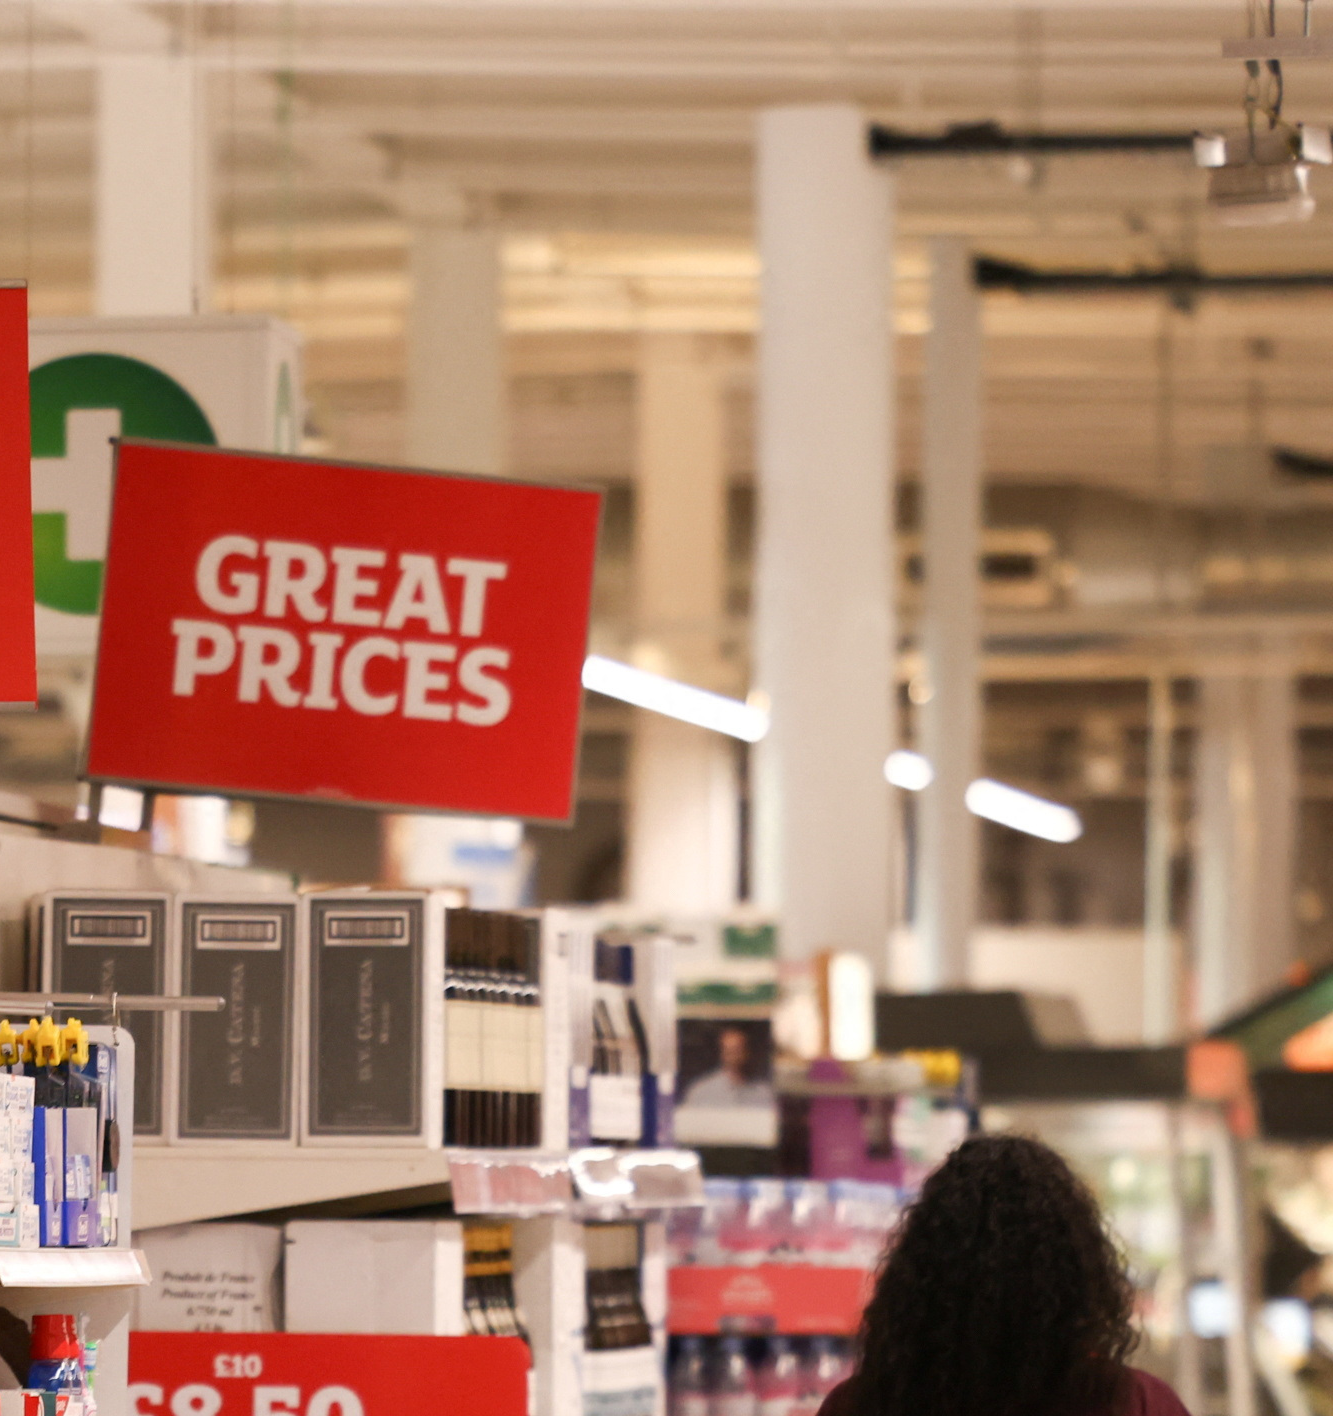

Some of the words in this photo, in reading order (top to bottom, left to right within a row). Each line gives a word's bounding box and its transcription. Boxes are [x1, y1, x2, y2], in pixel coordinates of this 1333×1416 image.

[194, 533, 509, 640] GREAT
[171, 617, 514, 729] PRICES
[213, 1353, 263, 1378] £10
